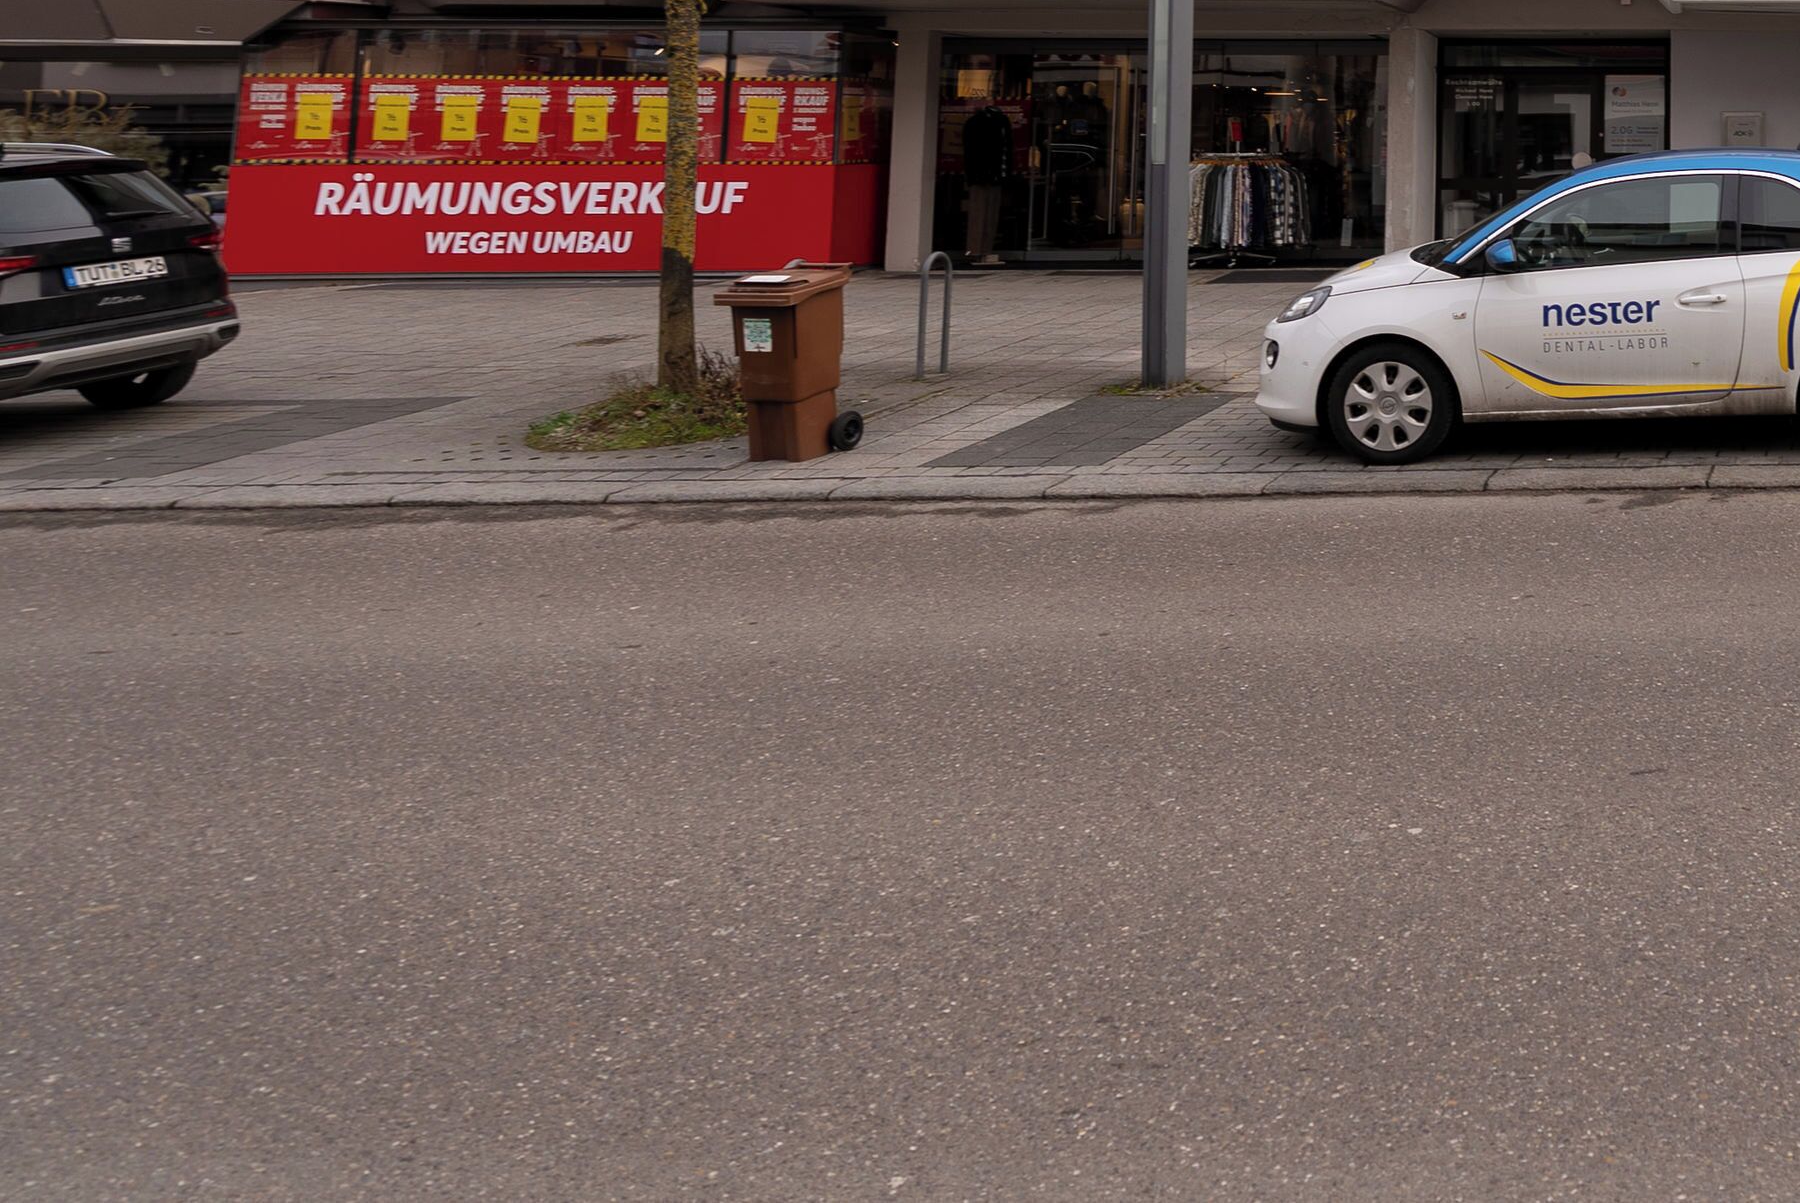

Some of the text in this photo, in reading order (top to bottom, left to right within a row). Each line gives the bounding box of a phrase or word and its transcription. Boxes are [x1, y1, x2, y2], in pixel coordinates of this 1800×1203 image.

[313, 172, 750, 216] RÄUMUNGSVERKUF
[425, 230, 634, 255] WEGEN UMBAU
[75, 264, 109, 283] TUT
[1542, 299, 1661, 327] nester
[1543, 336, 1669, 354] DENTAL-LABOR
